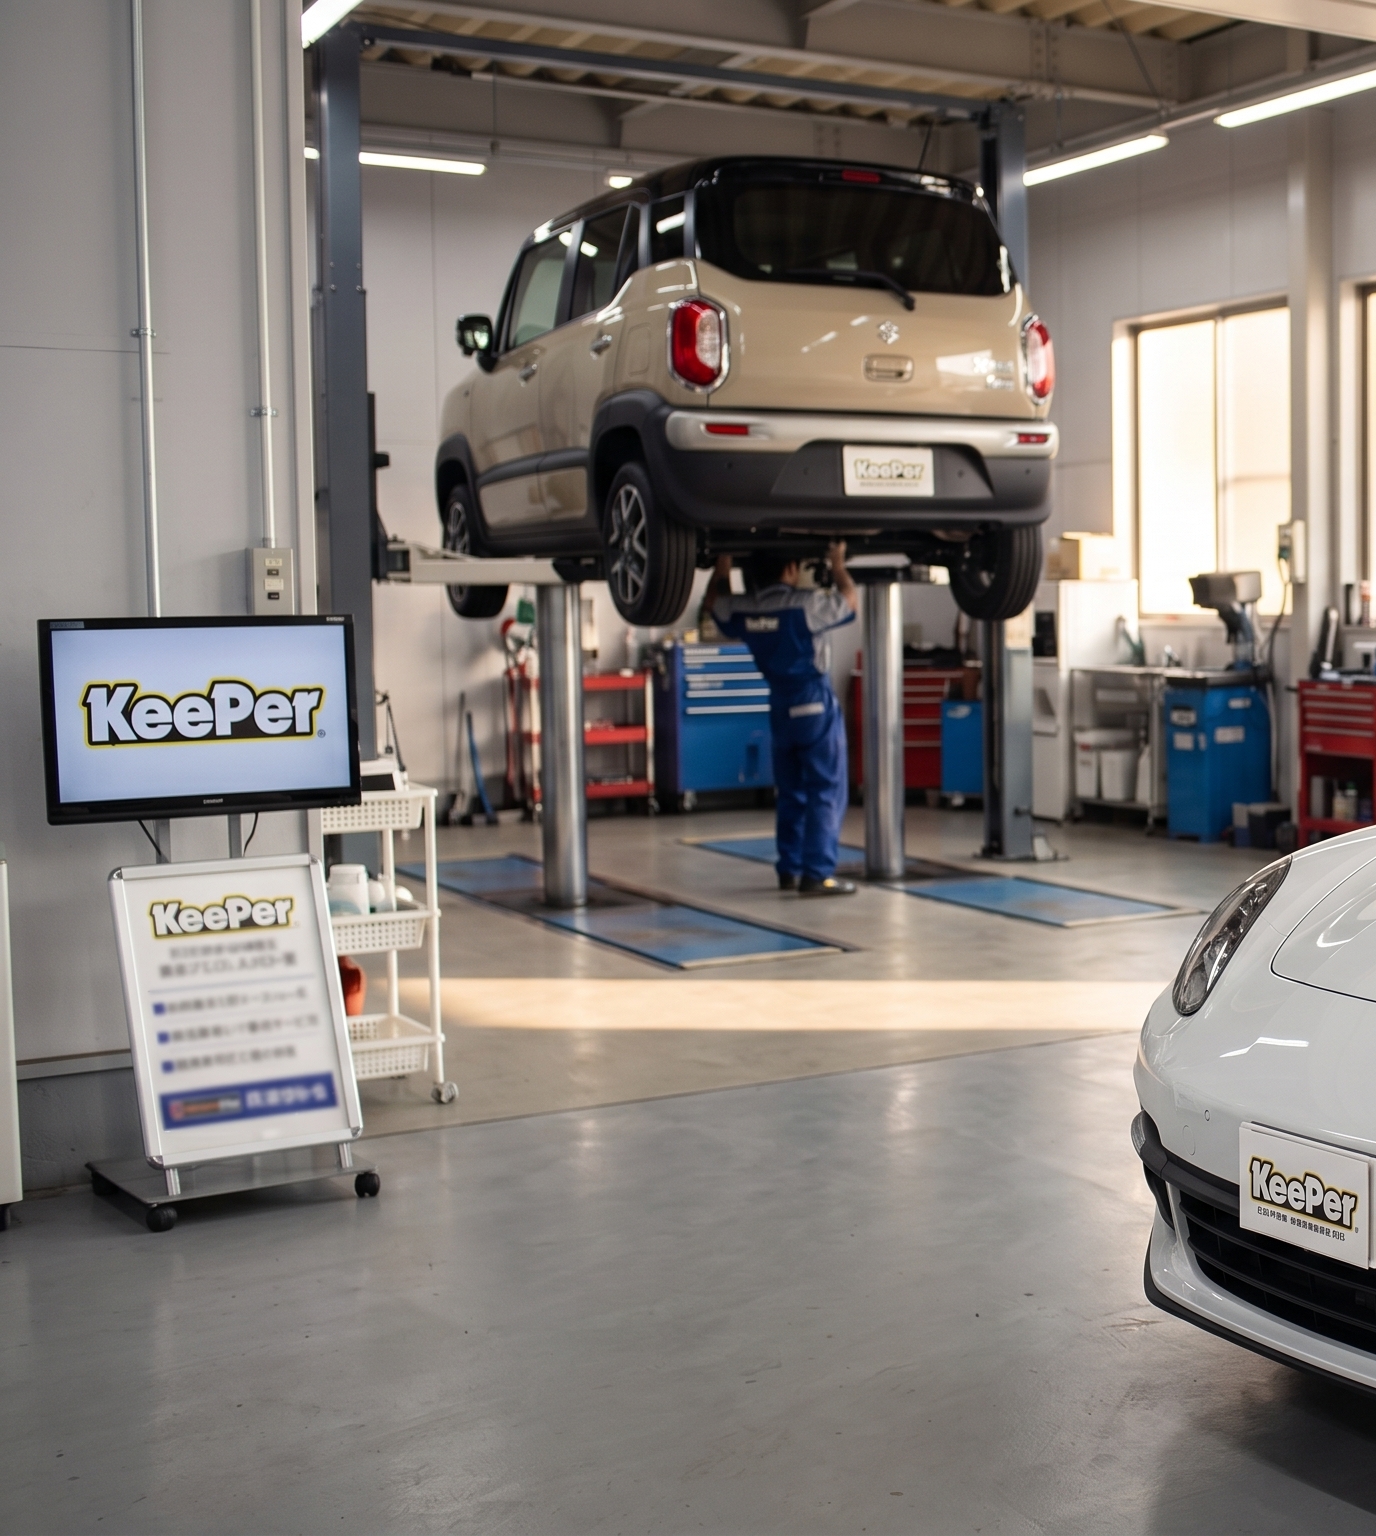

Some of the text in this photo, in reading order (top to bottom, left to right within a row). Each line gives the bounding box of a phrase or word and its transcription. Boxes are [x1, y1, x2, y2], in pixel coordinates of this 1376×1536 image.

[855, 459, 924, 480] KeePer
[82, 680, 324, 746] KeePer
[149, 897, 293, 938] KeePer
[1250, 1156, 1358, 1230] KeePer
